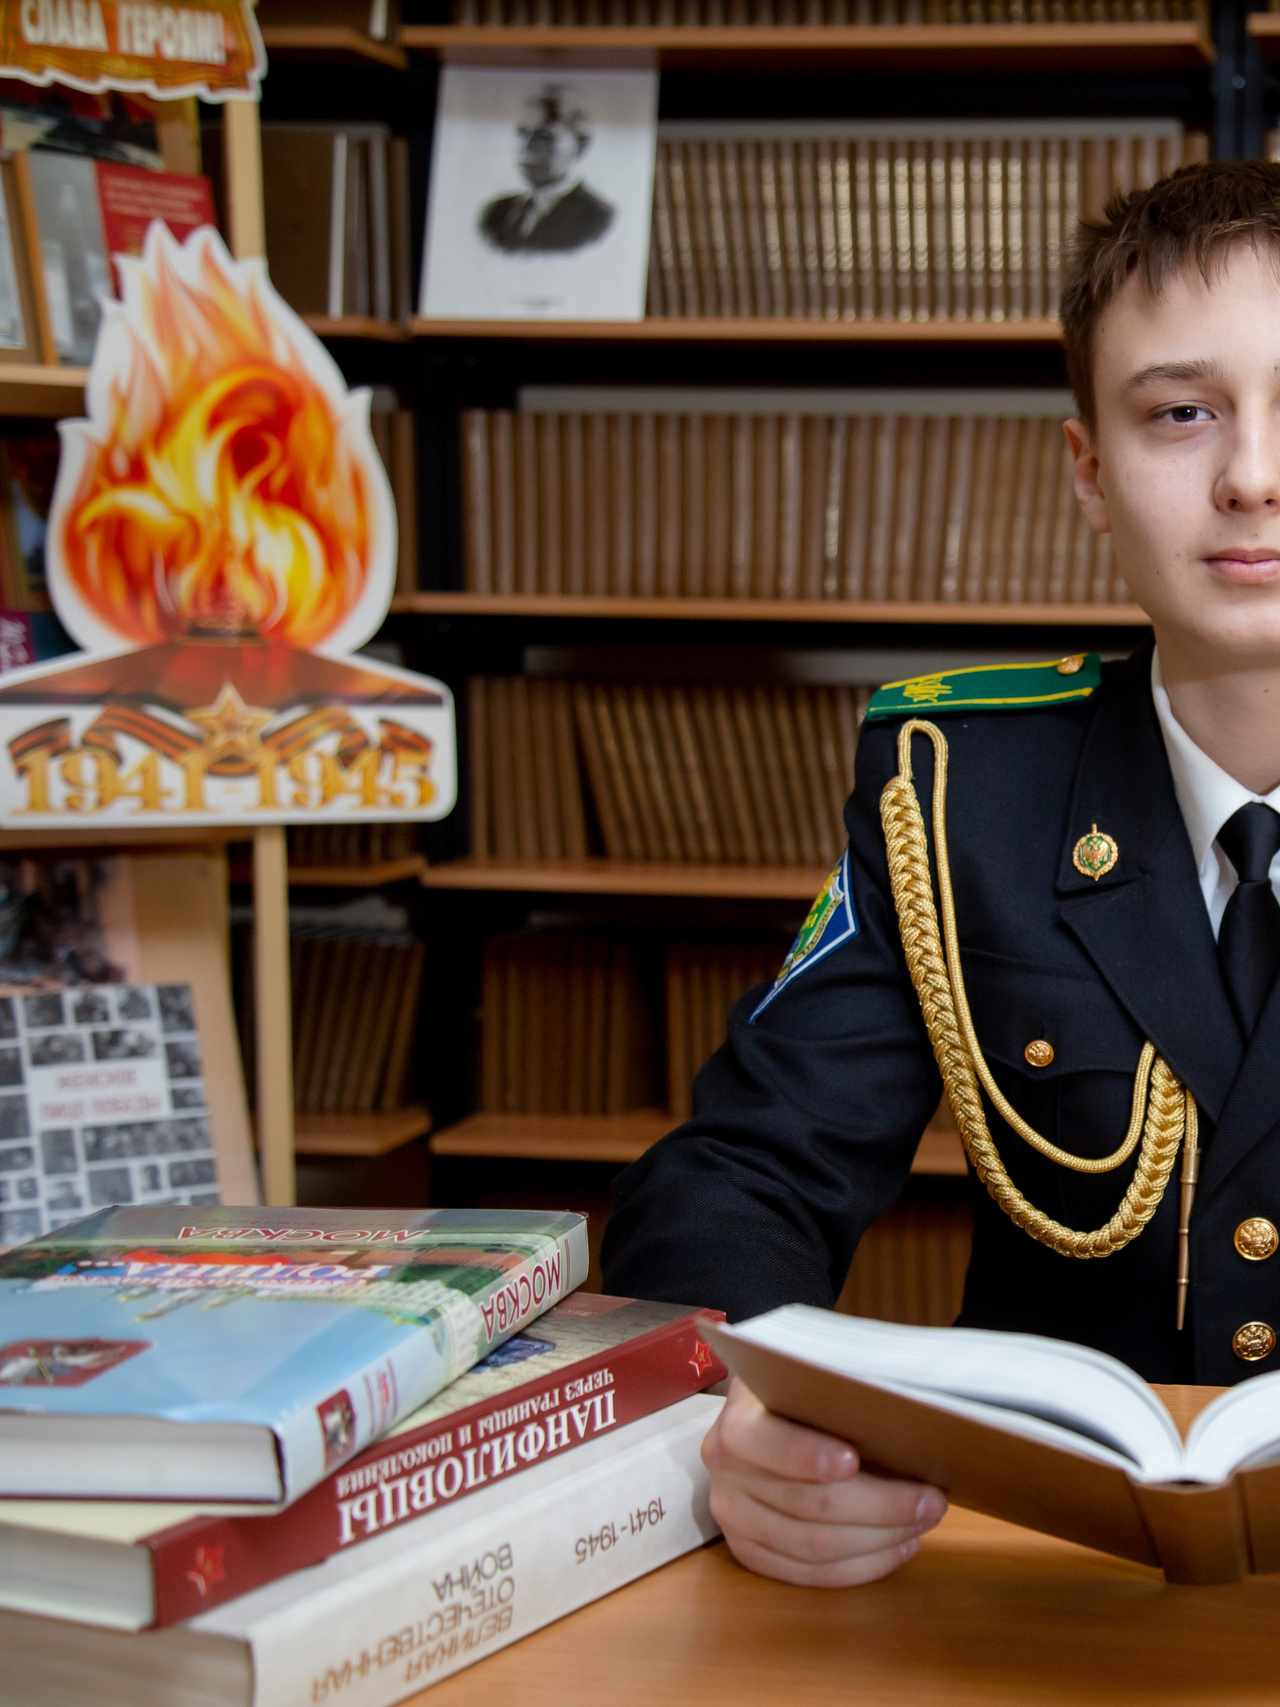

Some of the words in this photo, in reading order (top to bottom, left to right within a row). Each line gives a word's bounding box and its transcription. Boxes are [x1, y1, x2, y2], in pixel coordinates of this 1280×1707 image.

[20, 0, 109, 52] СЛАВА
[178, 1226, 430, 1242] МОСКВА
[479, 1250, 561, 1344] МОСКВА
[477, 1388, 561, 1438] ГРАНИЦЫ
[565, 1368, 615, 1401] ЧЕРЕЗ
[459, 1424, 473, 1445] И
[335, 1432, 453, 1498] ПОКОЛЕНИЯ
[336, 1388, 618, 1546] ПАНФИЛОВЦЫ
[431, 1543, 514, 1601] ВОЙНА
[310, 1575, 516, 1703] ОТЕЧЕСТВЕННАЯ
[403, 1605, 514, 1683] ВЕЛИКАЯ
